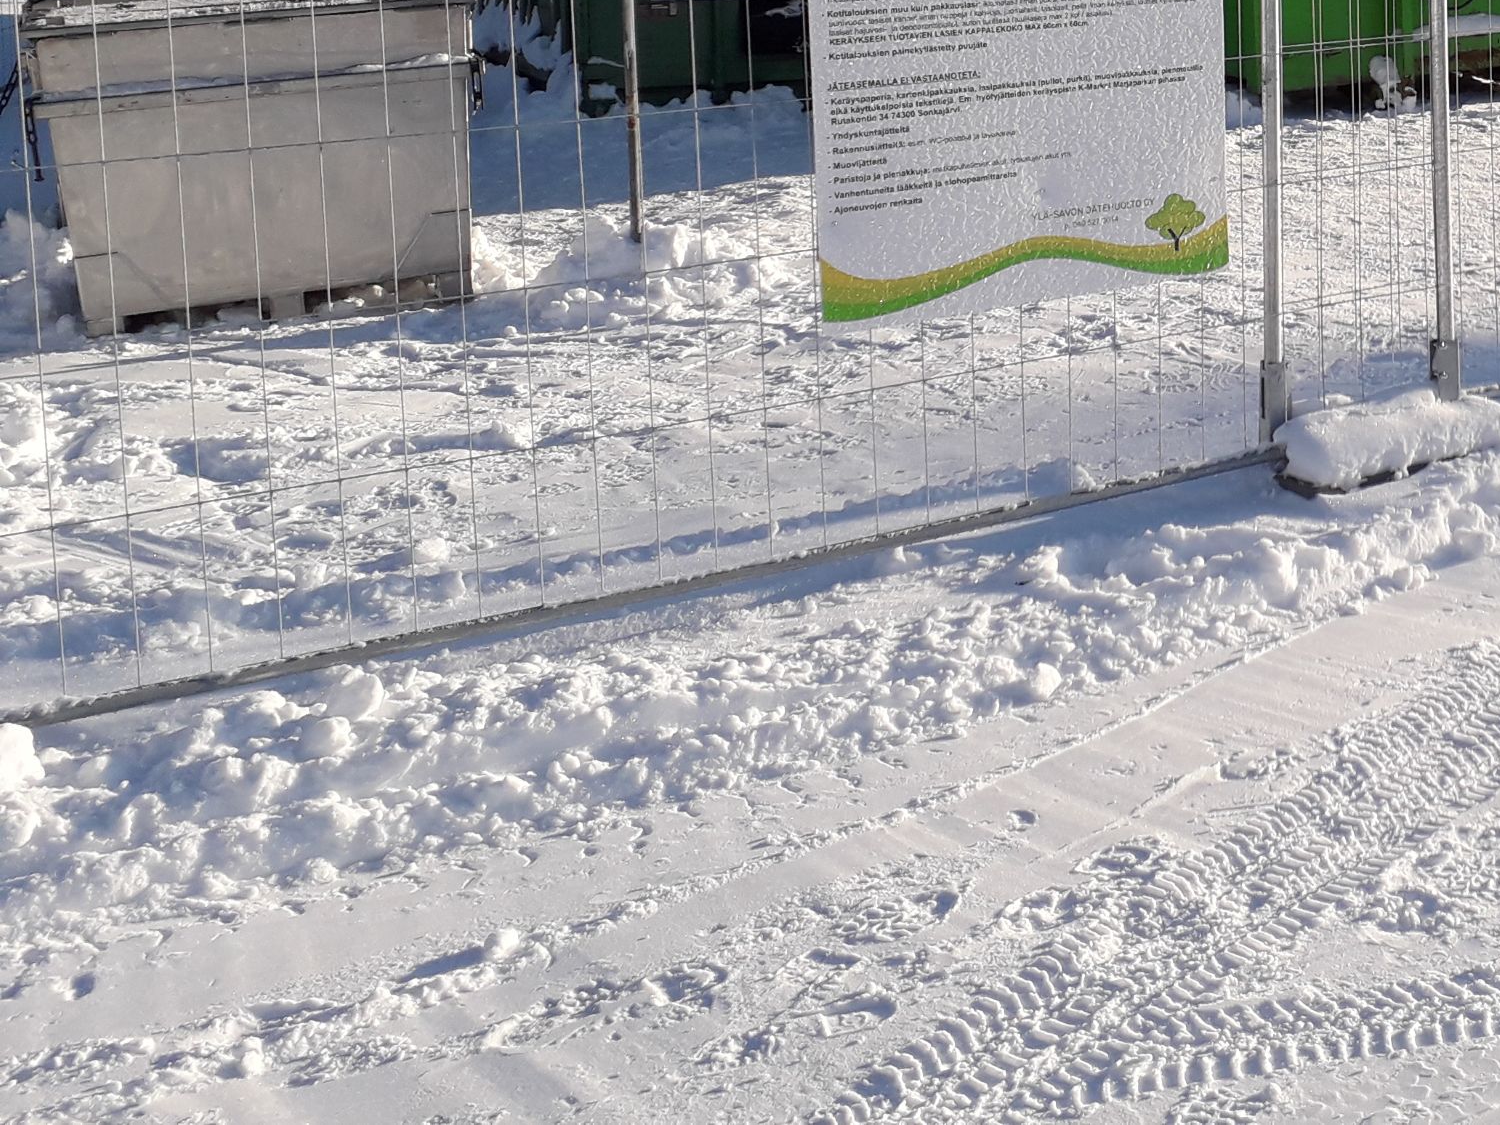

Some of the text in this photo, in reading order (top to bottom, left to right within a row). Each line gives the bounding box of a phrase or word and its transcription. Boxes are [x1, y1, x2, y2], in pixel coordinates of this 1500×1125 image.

[826, 7, 887, 18] Kotitalouksien
[890, 6, 908, 14] muu
[828, 33, 886, 45] KERÄYKSEEN
[934, 29, 962, 37] LASIEN
[964, 25, 1023, 35] KAPPALEKOKO
[828, 49, 890, 60] Kotitalouksien
[827, 77, 898, 91] JÄTEASEMALLA
[909, 70, 981, 84] VASTAANOTETA:
[830, 106, 848, 114] eikä
[890, 110, 915, 119] 74300
[833, 172, 871, 184] Paristoja
[873, 172, 880, 180] ja
[833, 171, 1017, 199] Vanhentuneita lääkkeitä ja elohopeamittareita
[833, 201, 887, 214] Ajoneuvojen
